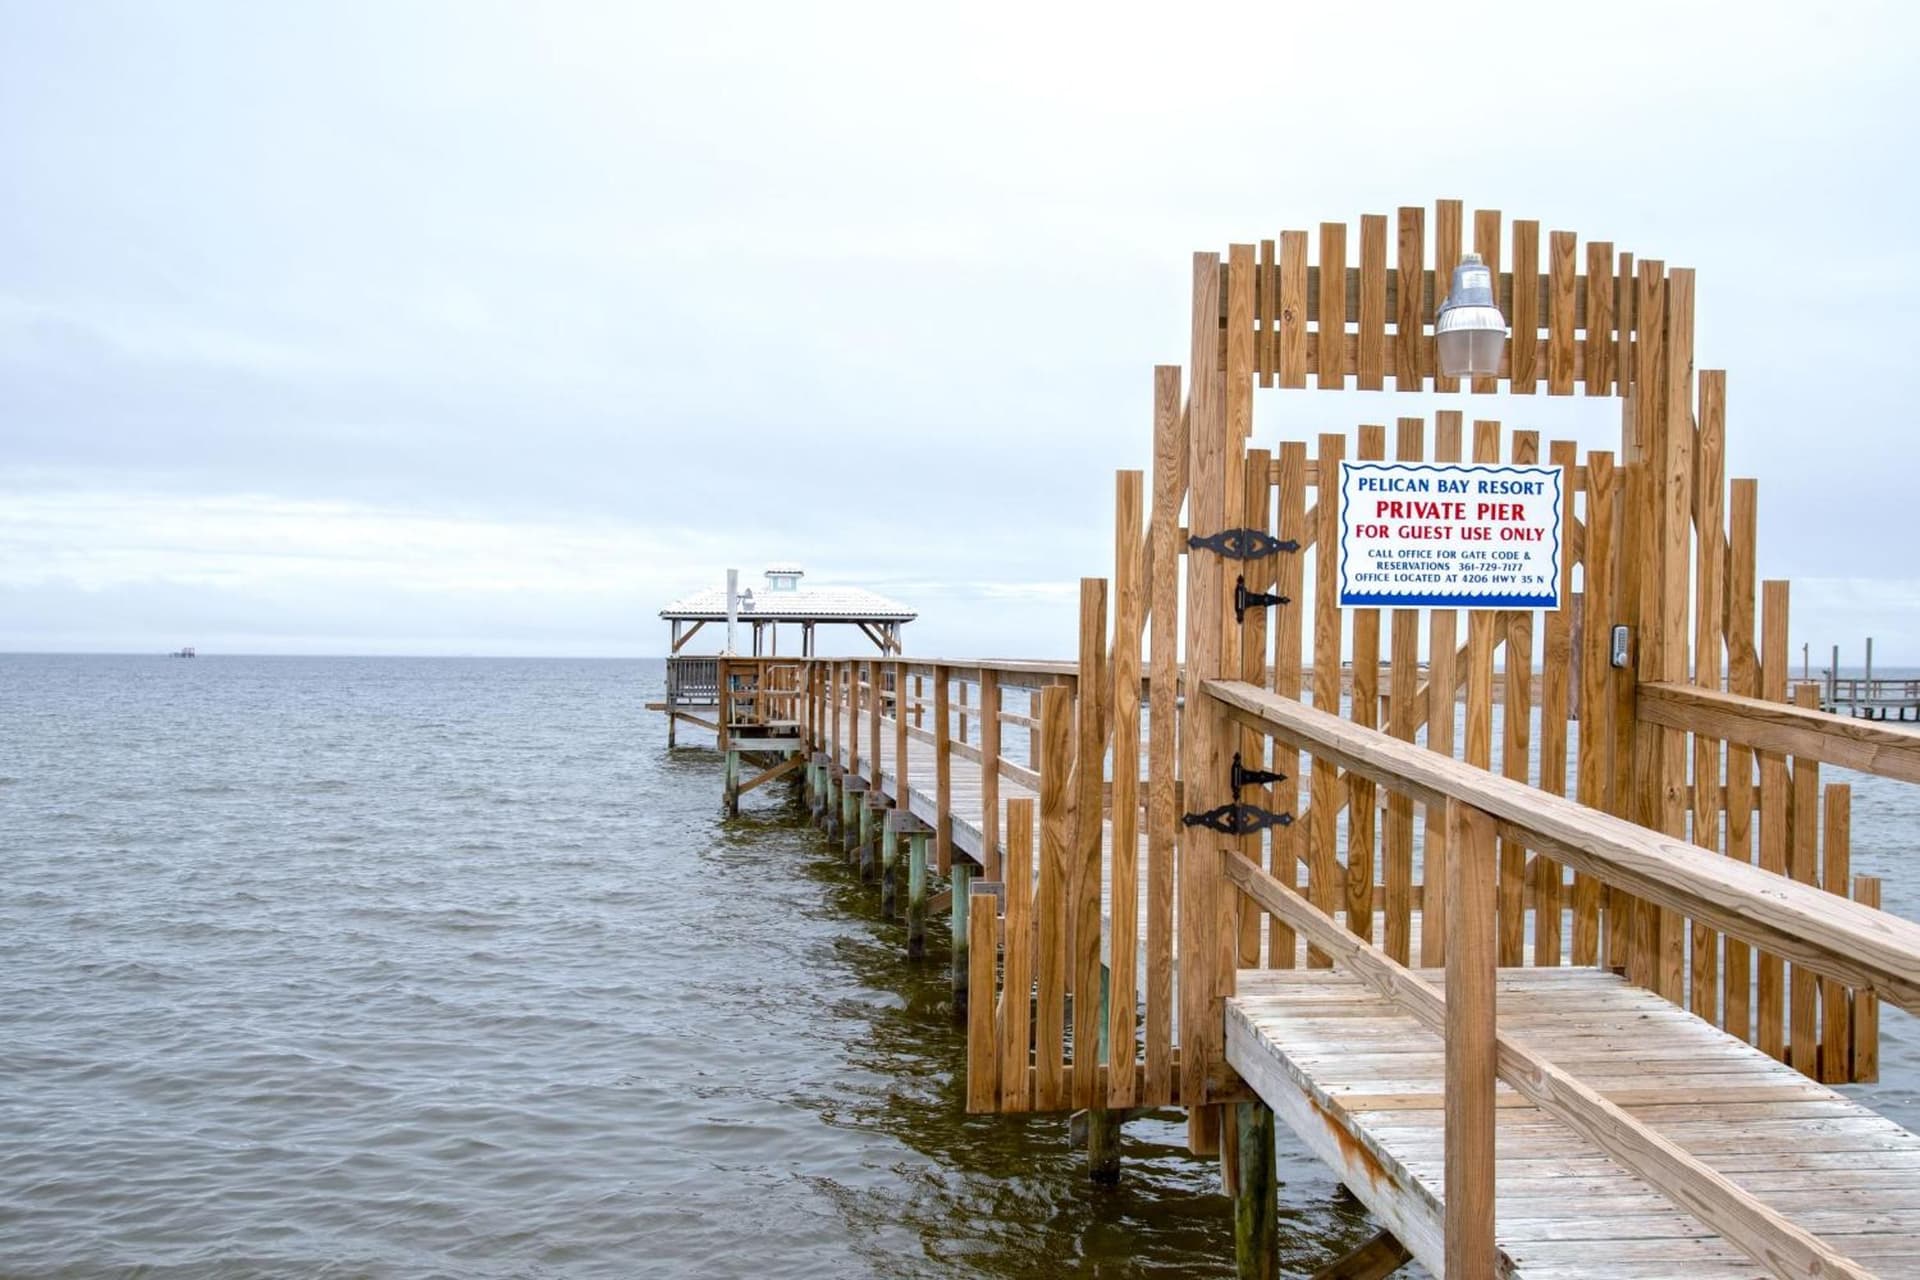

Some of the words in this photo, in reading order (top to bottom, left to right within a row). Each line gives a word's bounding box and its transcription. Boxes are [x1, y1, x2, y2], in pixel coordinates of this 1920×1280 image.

[1359, 478, 1429, 492] PELICAN
[1438, 480, 1470, 493] BAY
[1478, 481, 1544, 495] RESORT
[1376, 501, 1466, 520] PRIVATE
[1478, 504, 1526, 521] PIER
[1356, 525, 1389, 538] FOR
[1399, 526, 1453, 539] GUEST
[1461, 527, 1491, 540] USE
[1500, 528, 1545, 541] ONLY
[1368, 549, 1393, 558] CALL
[1398, 550, 1432, 559] OFFICE
[1437, 551, 1456, 559] FOR
[1461, 551, 1487, 559] GATE
[1524, 552, 1531, 560] &
[1377, 562, 1450, 570] RESERVATIONS
[1459, 563, 1523, 571] 361-729-7177
[1355, 573, 1389, 581] OFFICE
[1395, 574, 1441, 582] LOCATED
[1445, 574, 1457, 582] AT
[1462, 574, 1488, 583] 4206
[1493, 575, 1516, 583] HWY
[1537, 576, 1544, 584] N
